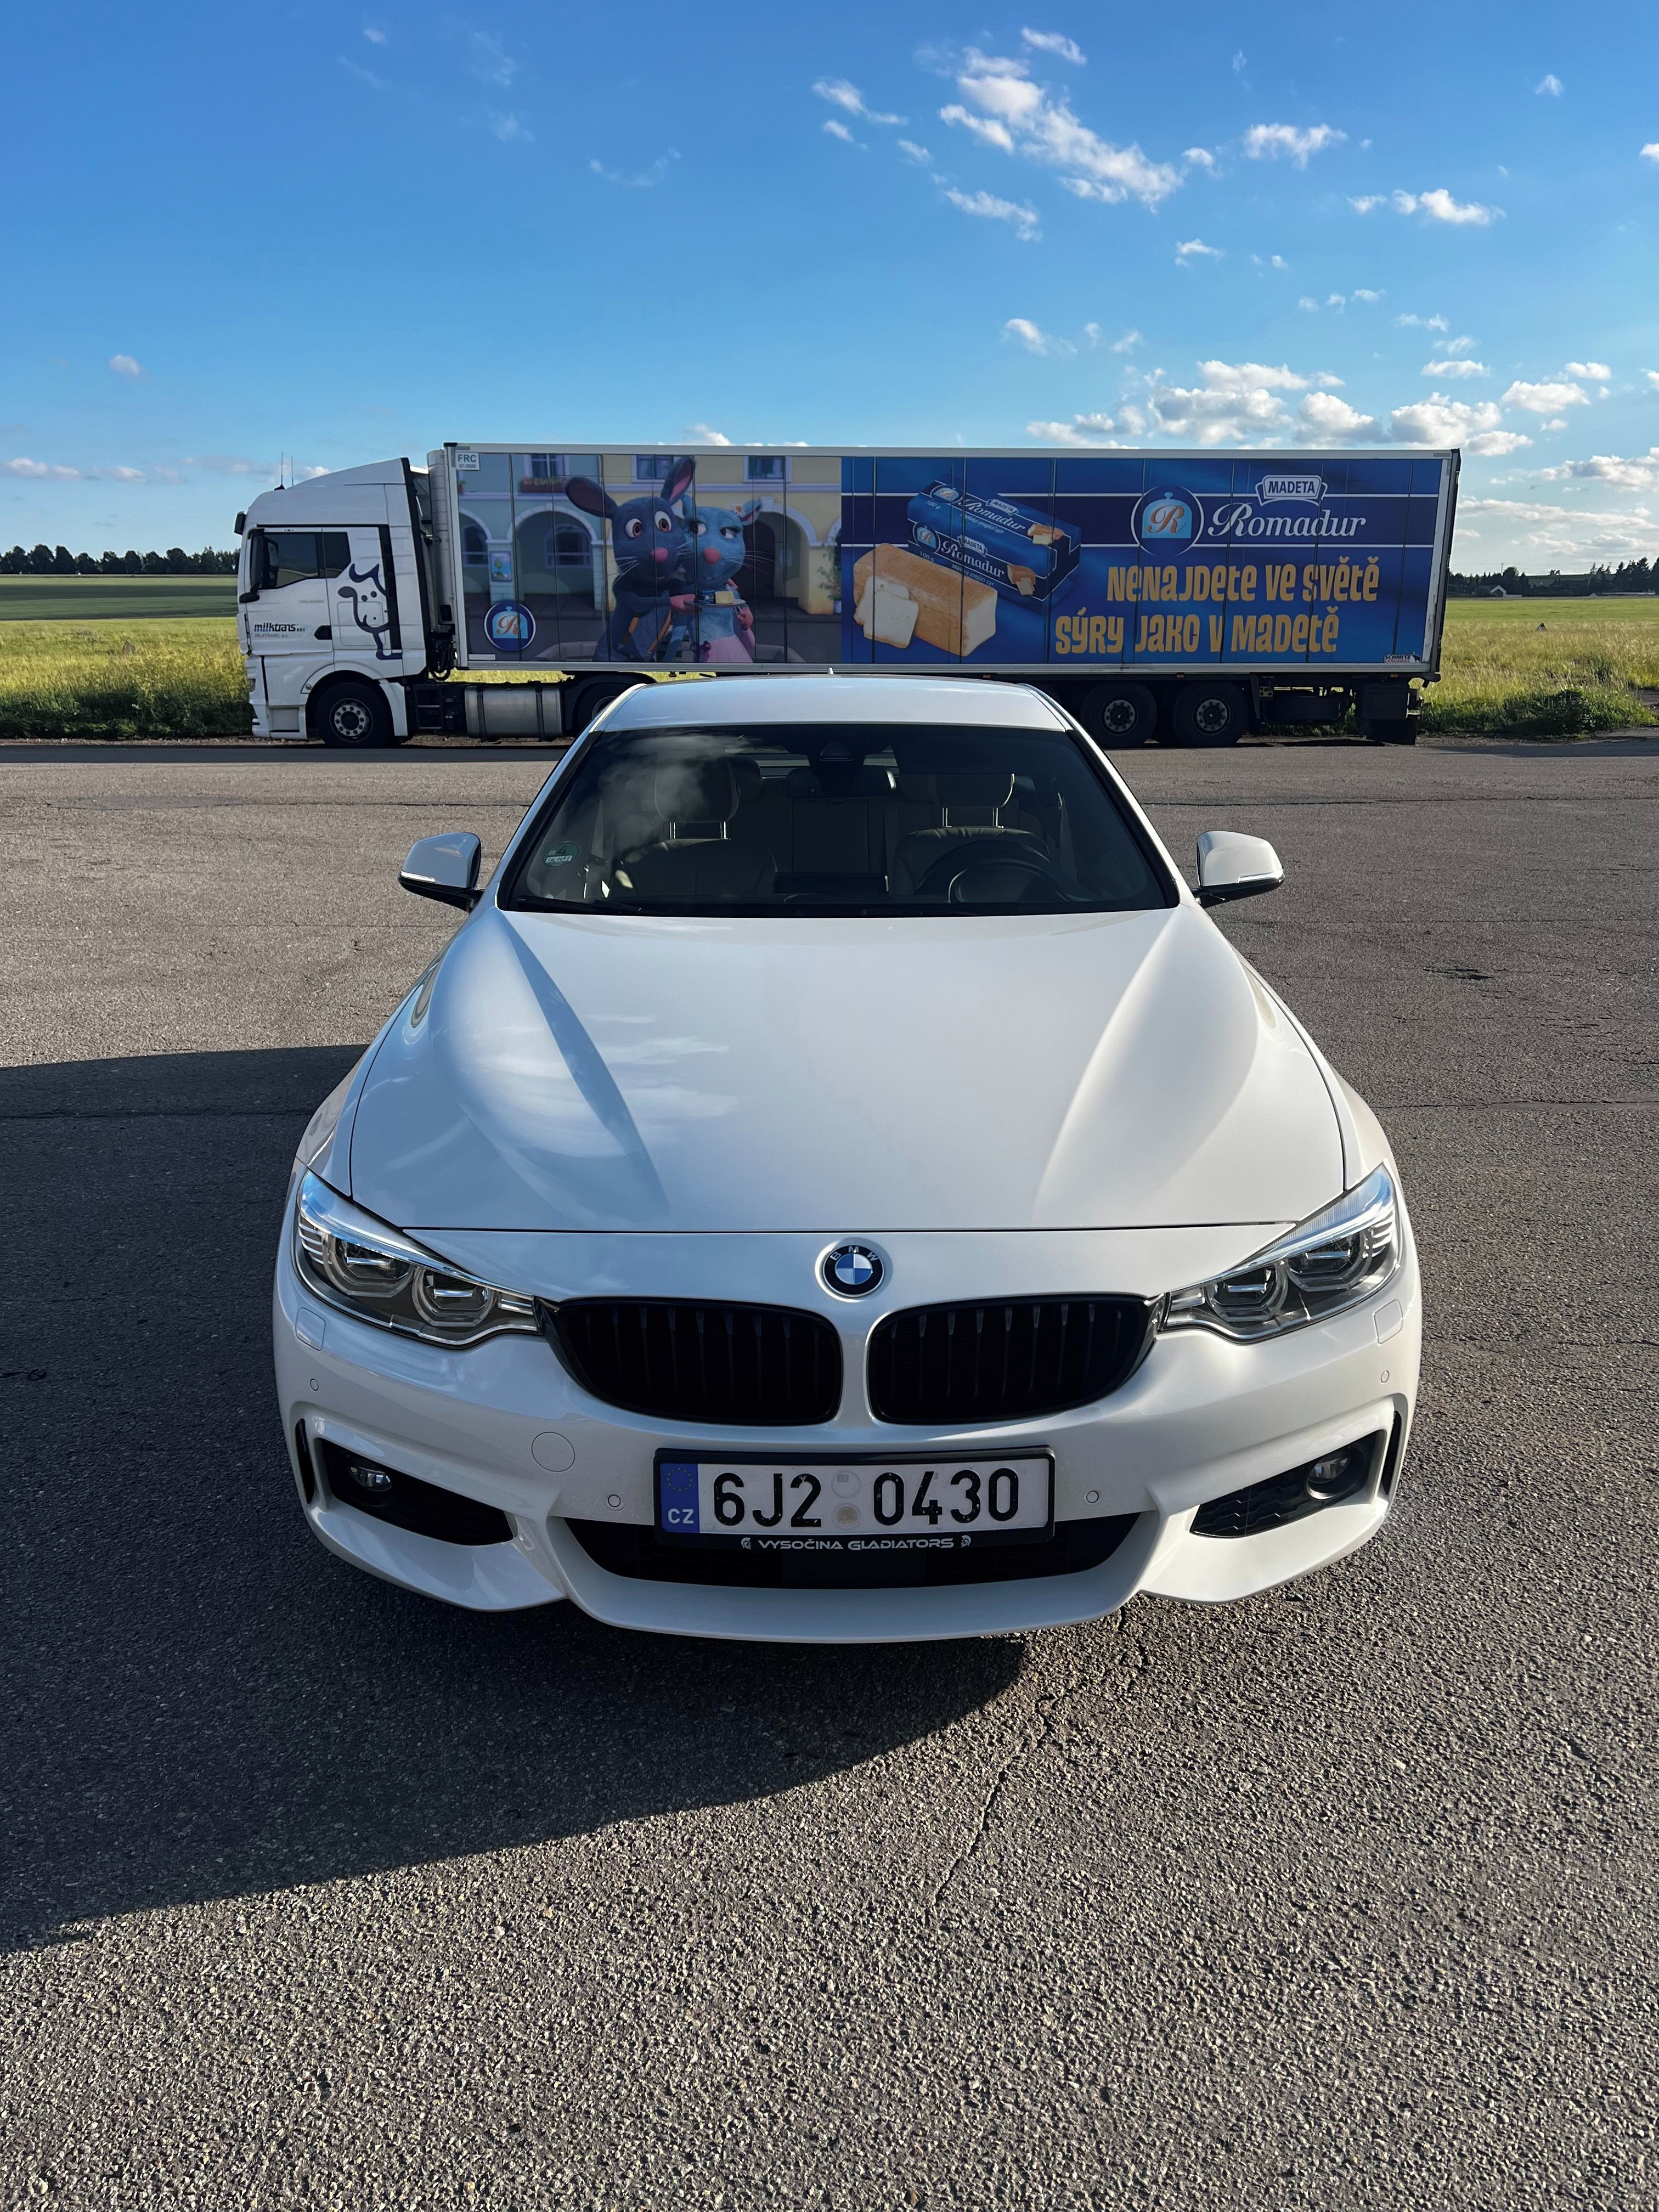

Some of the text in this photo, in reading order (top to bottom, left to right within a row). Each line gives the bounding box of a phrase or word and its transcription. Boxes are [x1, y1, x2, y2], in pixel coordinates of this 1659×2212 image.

[1268, 481, 1315, 494] MADETA
[993, 500, 1014, 512] MADETA
[958, 499, 1025, 530] Romadur
[1207, 502, 1366, 537] Romadur
[920, 551, 930, 560] 100
[941, 540, 1005, 577] Romadur
[556, 845, 567, 855] 4
[830, 1246, 879, 1261] BMW
[668, 1468, 1019, 1527] CZ 6J2 0430
[758, 1538, 955, 1550] VYSOČINA GLADIATORS
